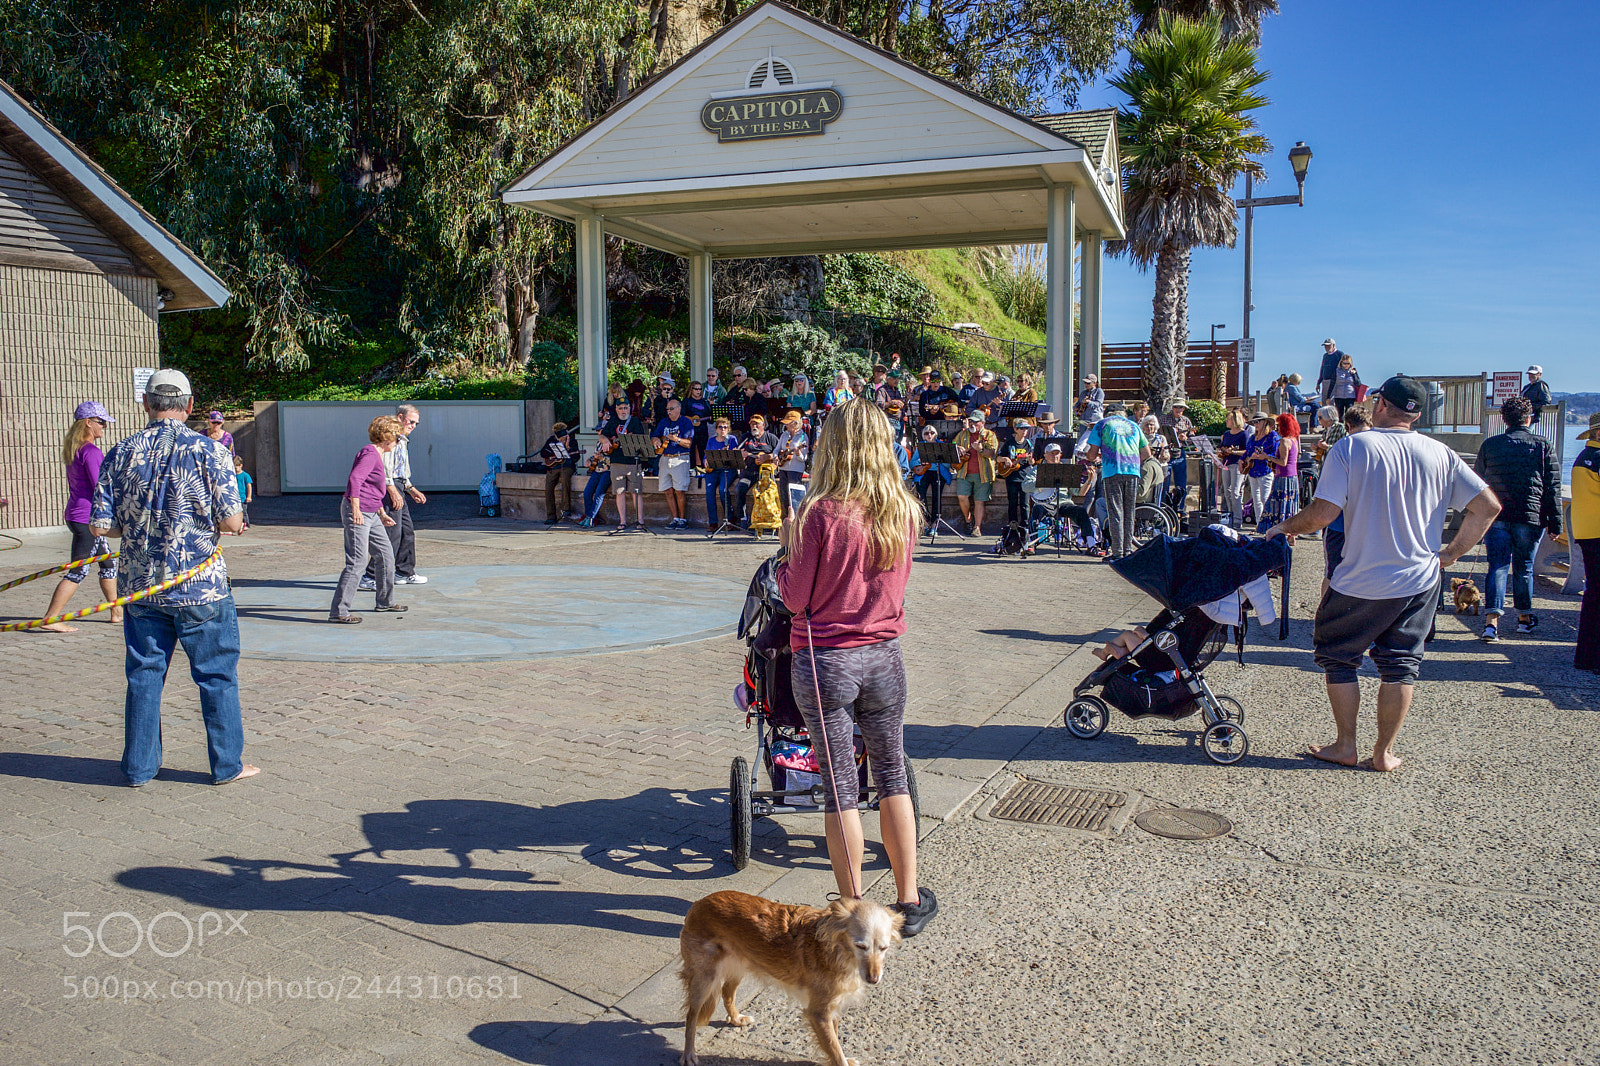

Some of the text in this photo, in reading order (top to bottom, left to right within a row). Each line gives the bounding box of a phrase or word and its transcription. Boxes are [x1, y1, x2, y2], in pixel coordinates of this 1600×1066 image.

[710, 96, 832, 123] CAPITOLA
[730, 120, 811, 135] BY THE SEA
